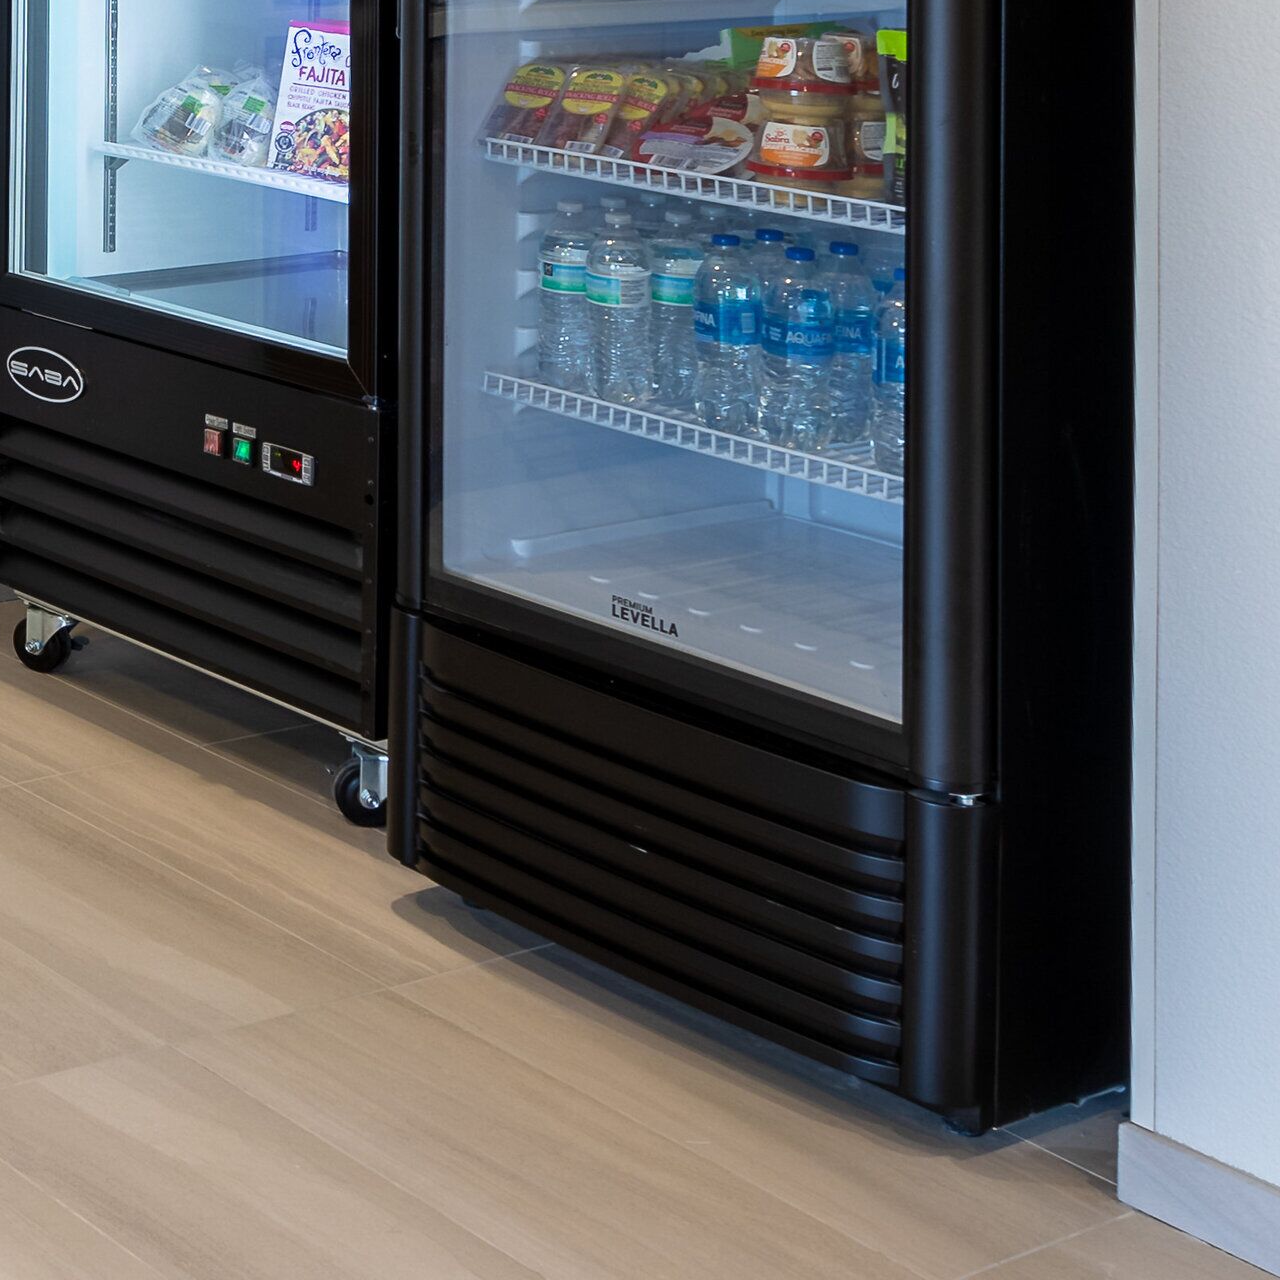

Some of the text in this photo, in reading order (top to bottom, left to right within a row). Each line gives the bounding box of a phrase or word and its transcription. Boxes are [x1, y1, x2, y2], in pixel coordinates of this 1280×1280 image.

[299, 65, 345, 86] FAJITA
[318, 90, 346, 100] CHICKEN
[765, 133, 790, 143] Sabra
[10, 360, 80, 391] SABA
[612, 594, 653, 615] PREMIUM
[611, 604, 679, 638] LEVELLA
